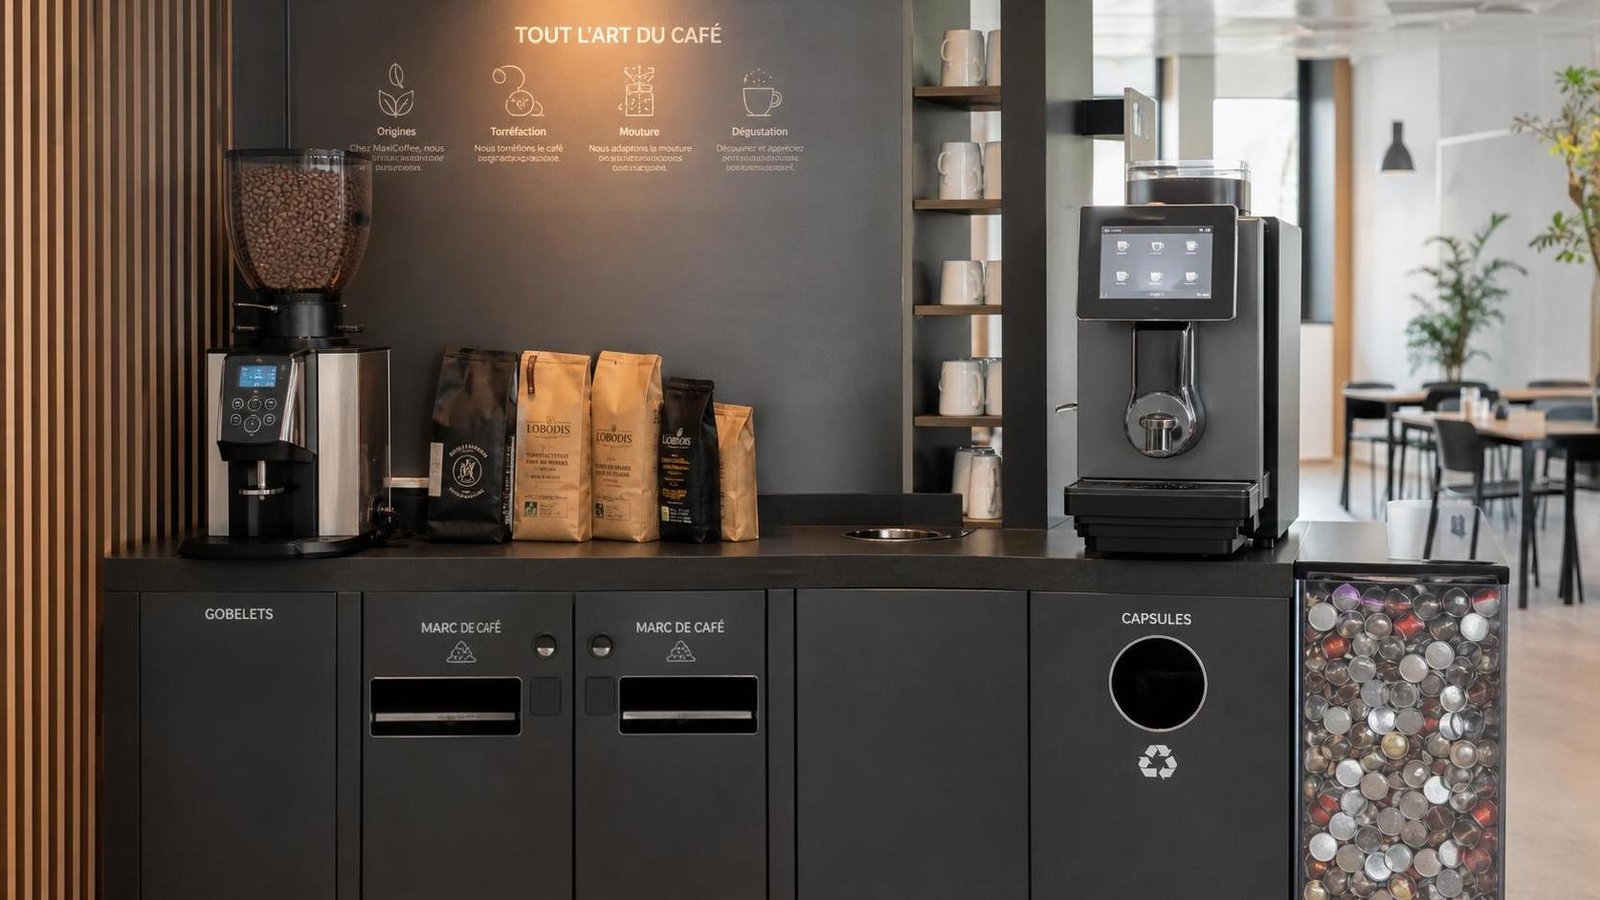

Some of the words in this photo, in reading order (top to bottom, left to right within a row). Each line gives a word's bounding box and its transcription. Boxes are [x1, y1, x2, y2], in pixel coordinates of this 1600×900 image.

[515, 26, 573, 44] TOUT
[577, 26, 630, 44] L'ART
[636, 26, 666, 44] DU
[671, 22, 723, 44] CAFÉ
[377, 126, 417, 138] Origines
[490, 126, 547, 137] Torréfaction
[619, 127, 660, 137] Mouture
[731, 126, 789, 139] Dégustation
[349, 144, 371, 153] Chez
[424, 145, 445, 153] nous
[474, 145, 496, 153] Nous
[546, 144, 564, 153] café
[588, 144, 610, 153] Nous
[658, 144, 693, 153] mouture
[526, 424, 571, 435] LOBODIS
[596, 432, 633, 444] LOBODIS
[204, 607, 274, 621] GOBELETS
[1121, 612, 1192, 626] CAPSULES
[420, 621, 457, 635] MARC
[459, 621, 475, 635] DE
[476, 619, 502, 635] CAFÉ
[636, 621, 672, 633] MARC
[675, 621, 691, 633] DE
[694, 618, 725, 634] CAFÉ
